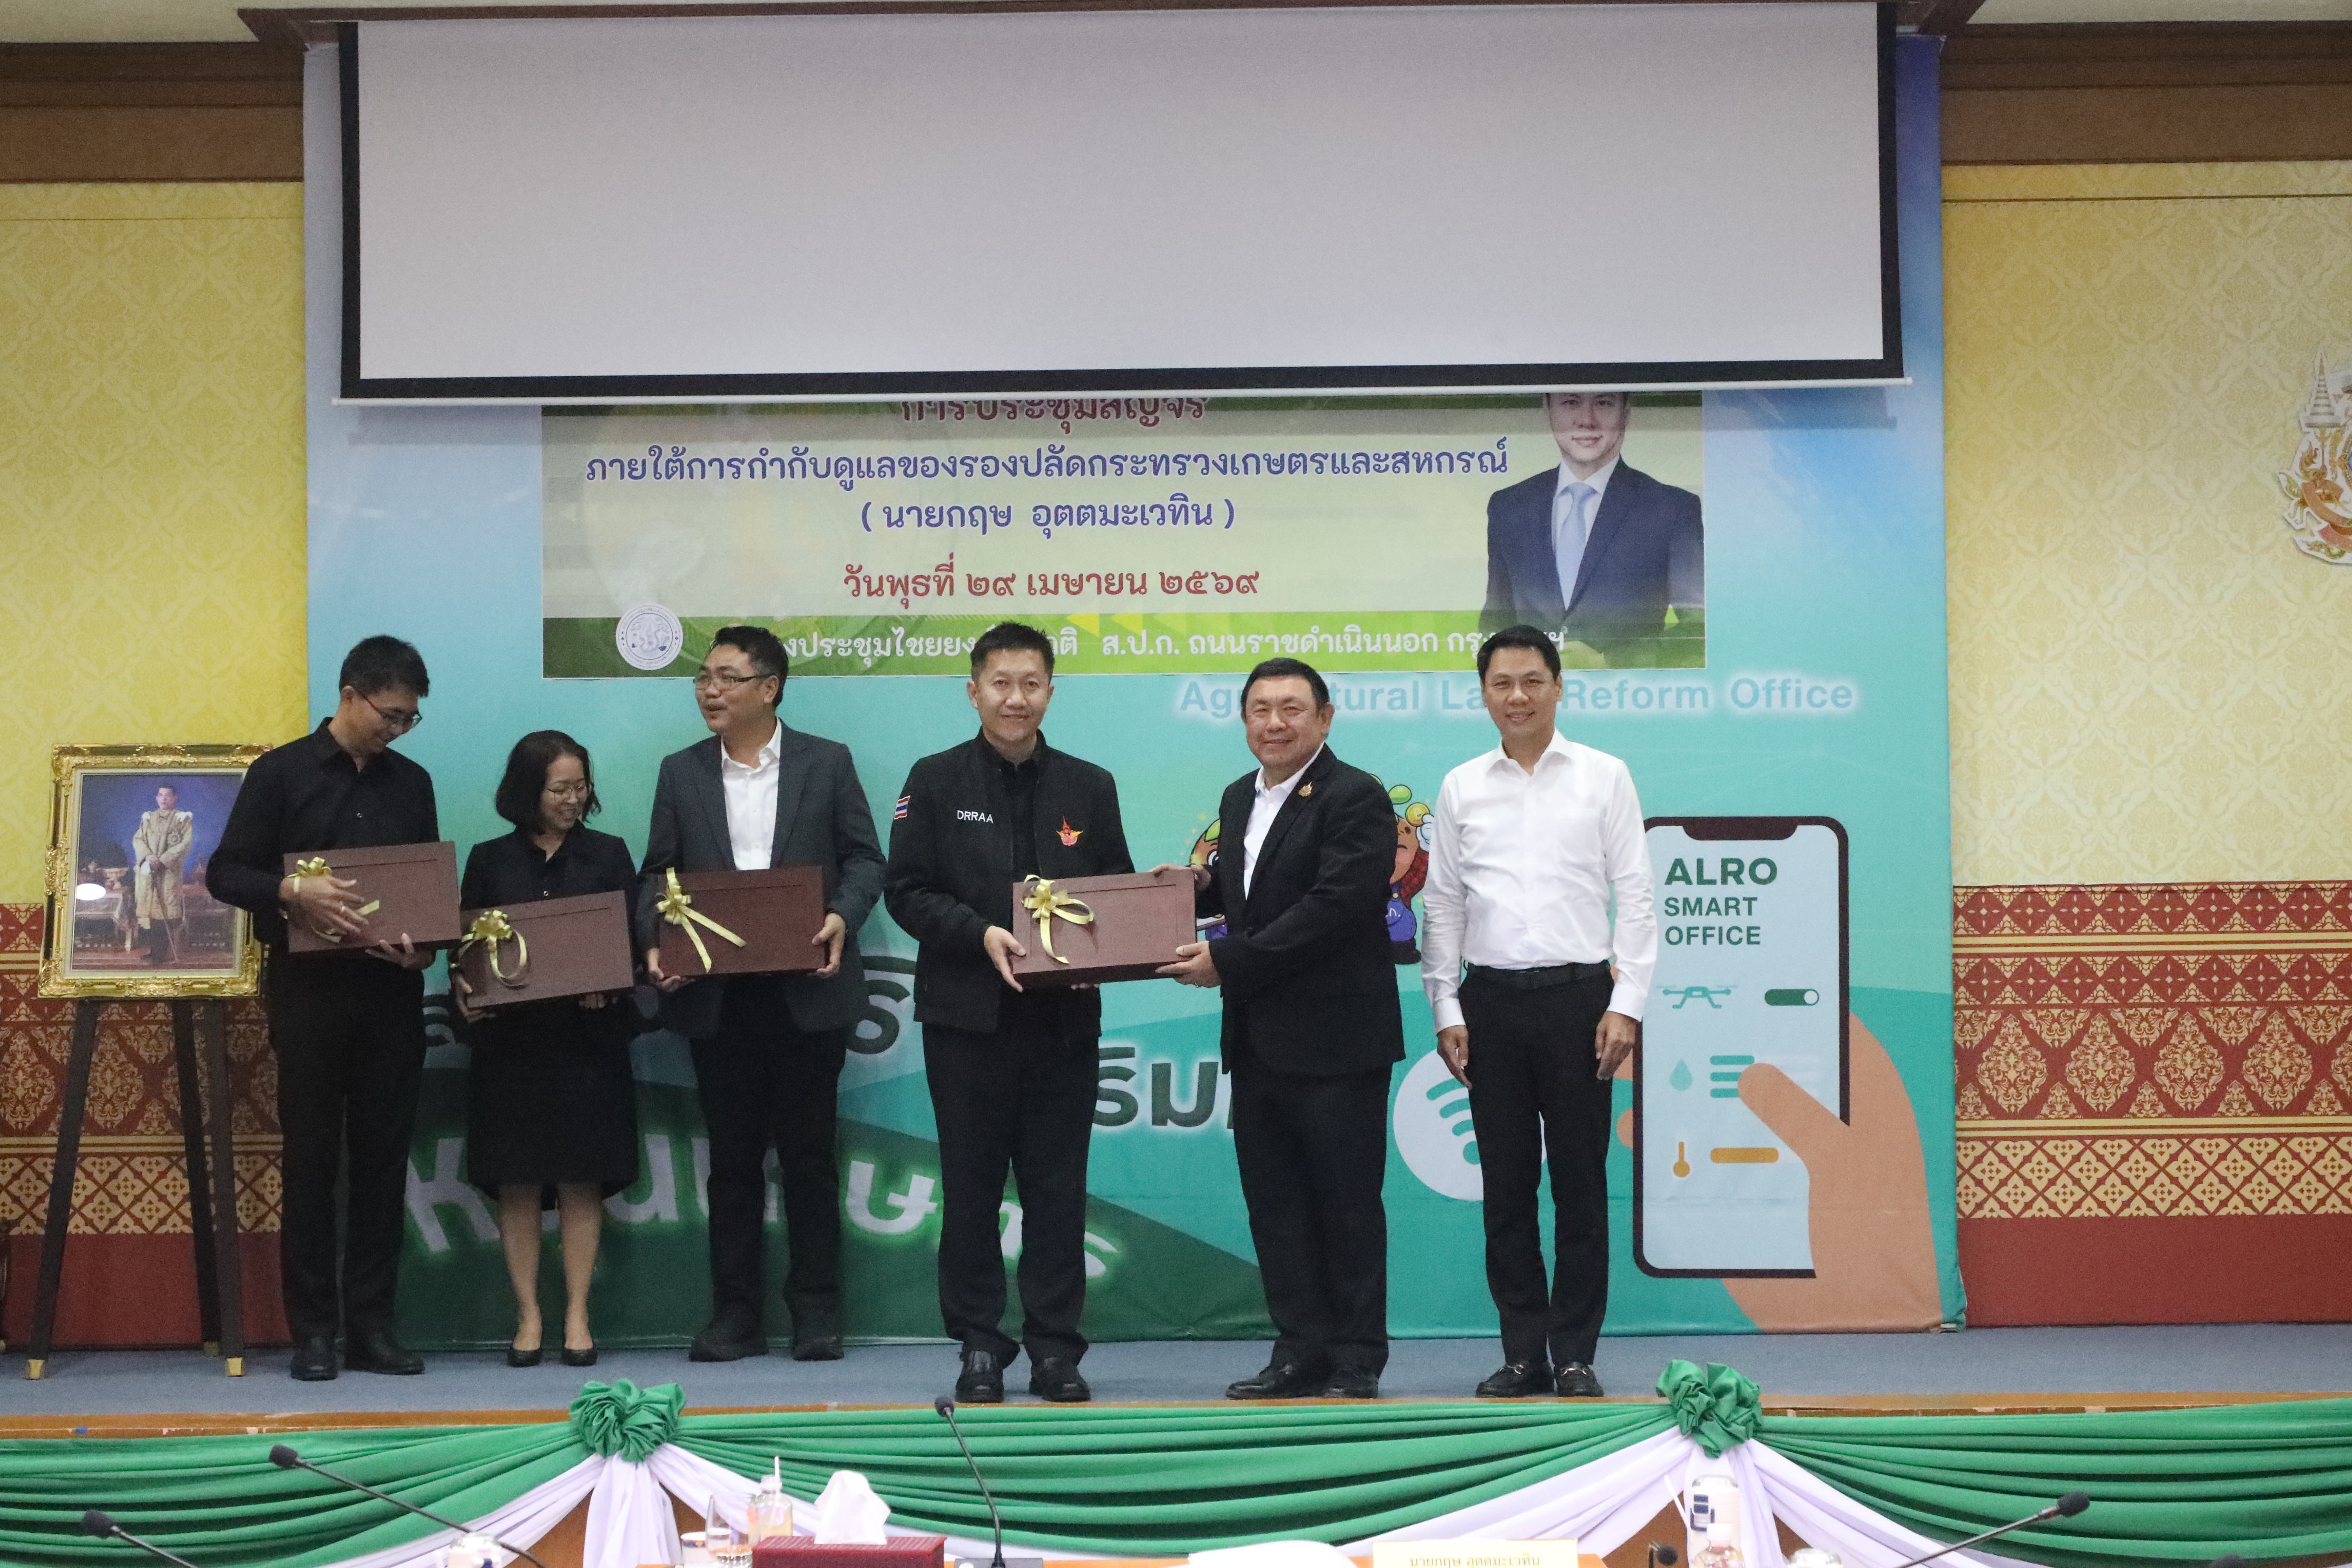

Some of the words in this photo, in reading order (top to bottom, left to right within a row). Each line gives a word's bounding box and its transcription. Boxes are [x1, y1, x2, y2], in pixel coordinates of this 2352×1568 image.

[901, 397, 1207, 435] การประชุมสญจร
[586, 436, 1508, 491] ภายใต้การกำกับดูแลของรองปลัดกระทรวงเกษตรและสหกรณ์
[883, 504, 1012, 535] นายกฤษ
[1032, 492, 1212, 539] อุตตมะเวทิน
[844, 552, 954, 609] วันพุธที่
[966, 572, 1016, 596] ๒๙
[1027, 571, 1147, 596] เมษายน
[1159, 570, 1259, 595] ๒๕๖๙
[1102, 630, 1180, 655] ส.ป.ก.
[1189, 624, 1438, 654] ถนนราชดำเนินนอก
[1180, 680, 1419, 719] Agtural
[1442, 680, 1483, 710] La
[1562, 678, 1709, 710] Reform
[1730, 677, 1854, 709] Office
[957, 810, 994, 824] DRRAA
[1664, 857, 1778, 886] ALRO
[1664, 897, 1758, 917] SMART
[1665, 925, 1761, 946] OFFICE
[1409, 1556, 1461, 1568] นายกฤษ
